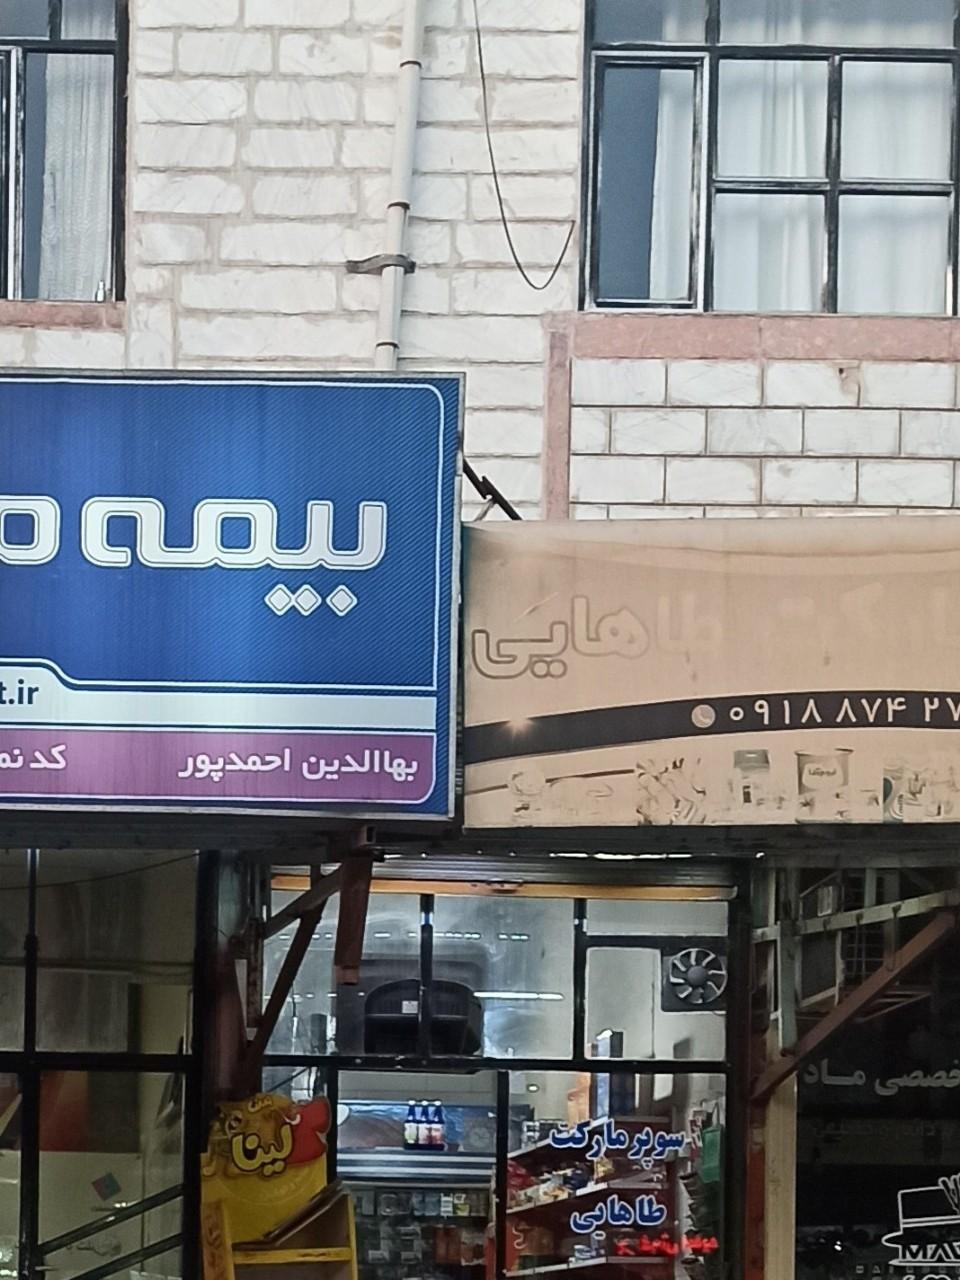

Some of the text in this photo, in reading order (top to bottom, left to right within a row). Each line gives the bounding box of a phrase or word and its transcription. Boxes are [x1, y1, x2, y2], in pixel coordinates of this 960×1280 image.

[81, 495, 387, 616] بیمه
[729, 699, 822, 725] ۰۹۱۸
[836, 697, 906, 722] ۸۷۴
[29, 744, 67, 770] کد
[178, 748, 419, 782] بهاالدین احمدپور
[549, 1119, 687, 1170] سوپر مارکت
[570, 1194, 668, 1241] طاهایی
